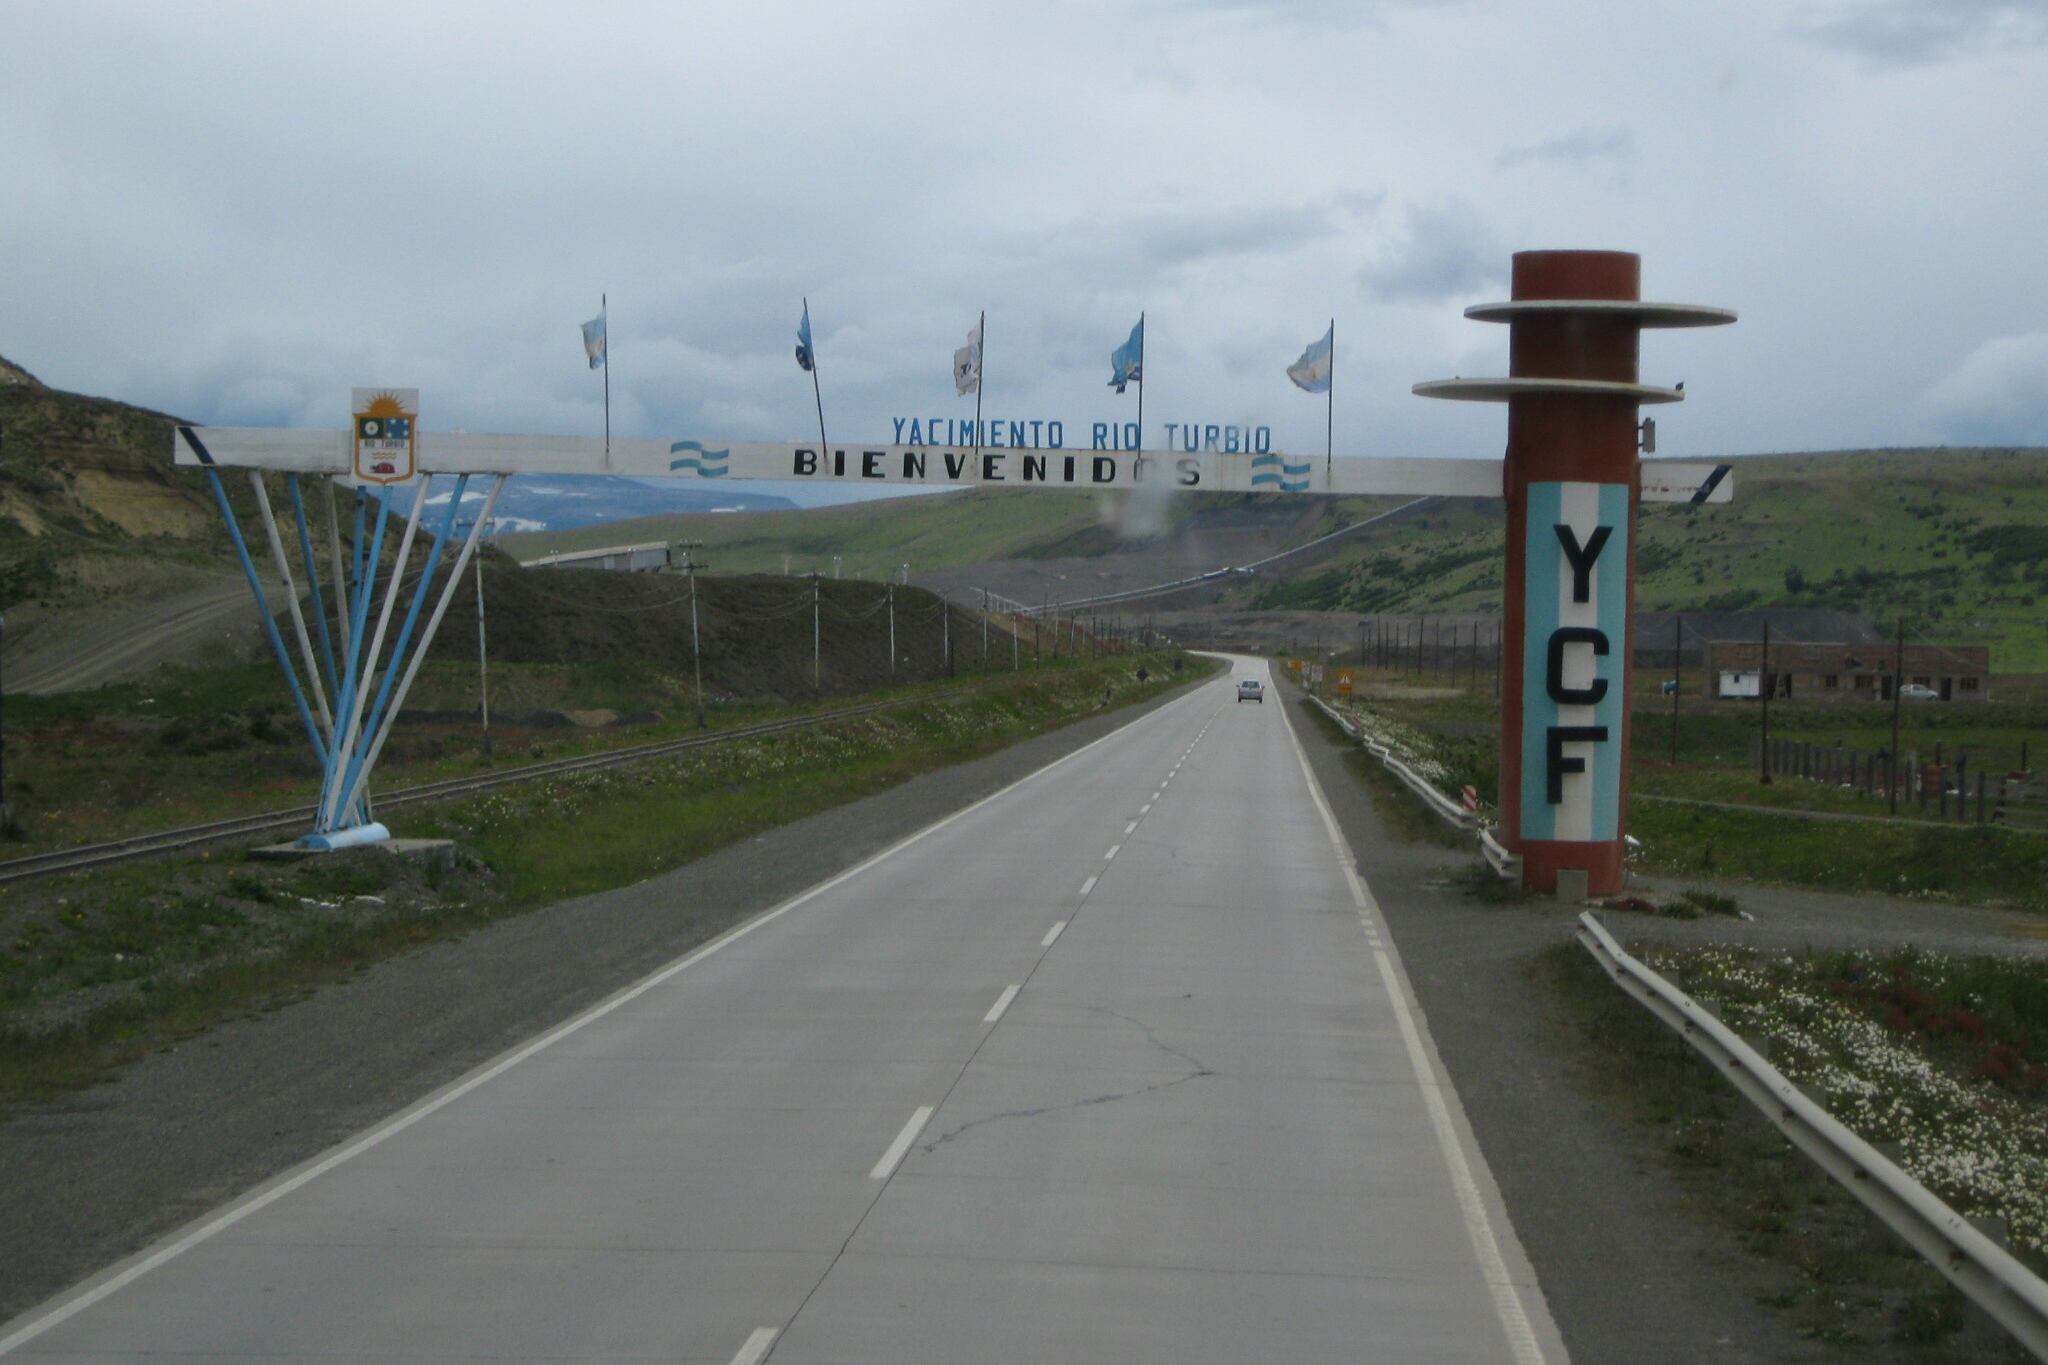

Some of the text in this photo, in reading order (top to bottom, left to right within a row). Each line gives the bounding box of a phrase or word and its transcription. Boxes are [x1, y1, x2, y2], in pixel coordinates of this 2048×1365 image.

[893, 417, 1270, 454] YACIMIENTO RIO TURBIO
[1546, 524, 1613, 804] YCF
